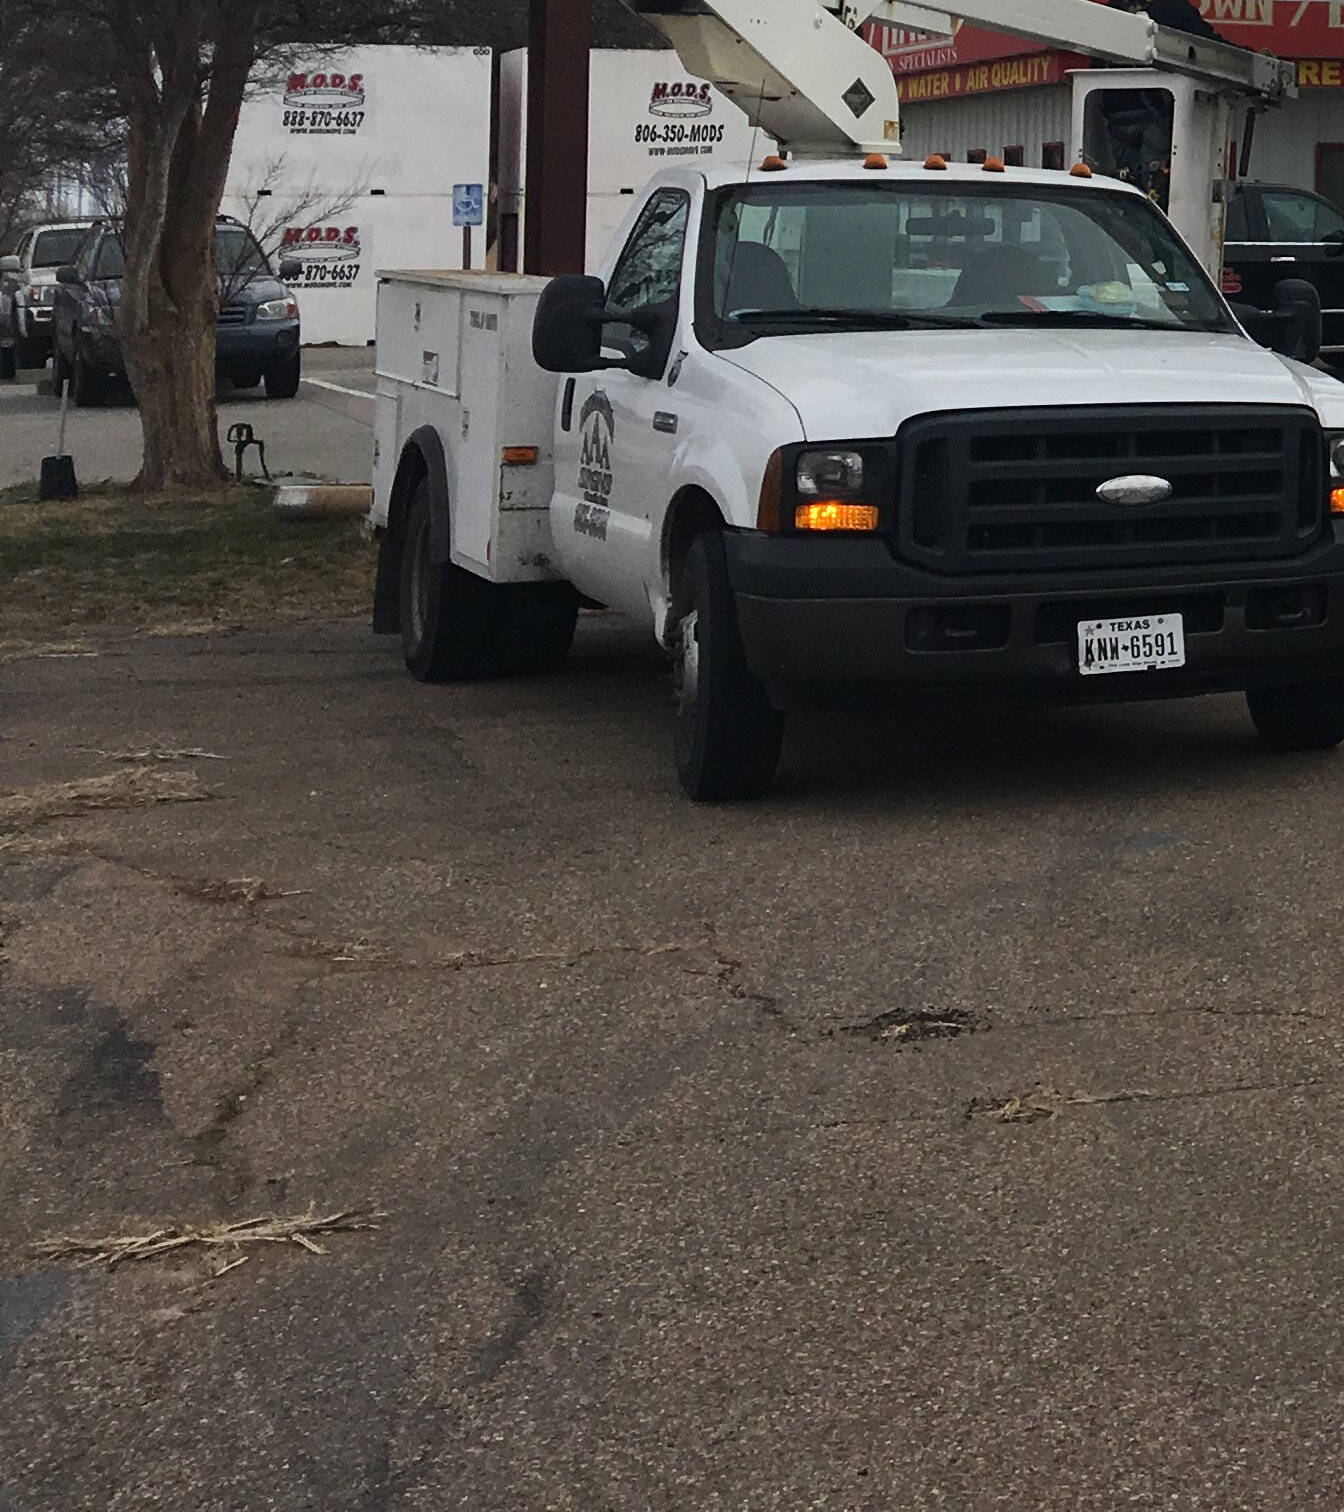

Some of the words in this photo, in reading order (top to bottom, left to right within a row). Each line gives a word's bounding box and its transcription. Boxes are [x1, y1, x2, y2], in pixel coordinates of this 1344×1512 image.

[900, 48, 957, 72] SPECIALISTS
[286, 73, 364, 94] M.O.D.S.
[909, 72, 949, 98] WATER
[966, 67, 988, 90] AIR
[991, 56, 1050, 87] QUALITY
[653, 82, 713, 103] M.O.D.S.
[283, 111, 365, 128] 888-870-6637
[634, 124, 725, 143] 806-350-MODS
[282, 226, 360, 247] M.O.D.S.
[1110, 619, 1151, 632] TEXAS
